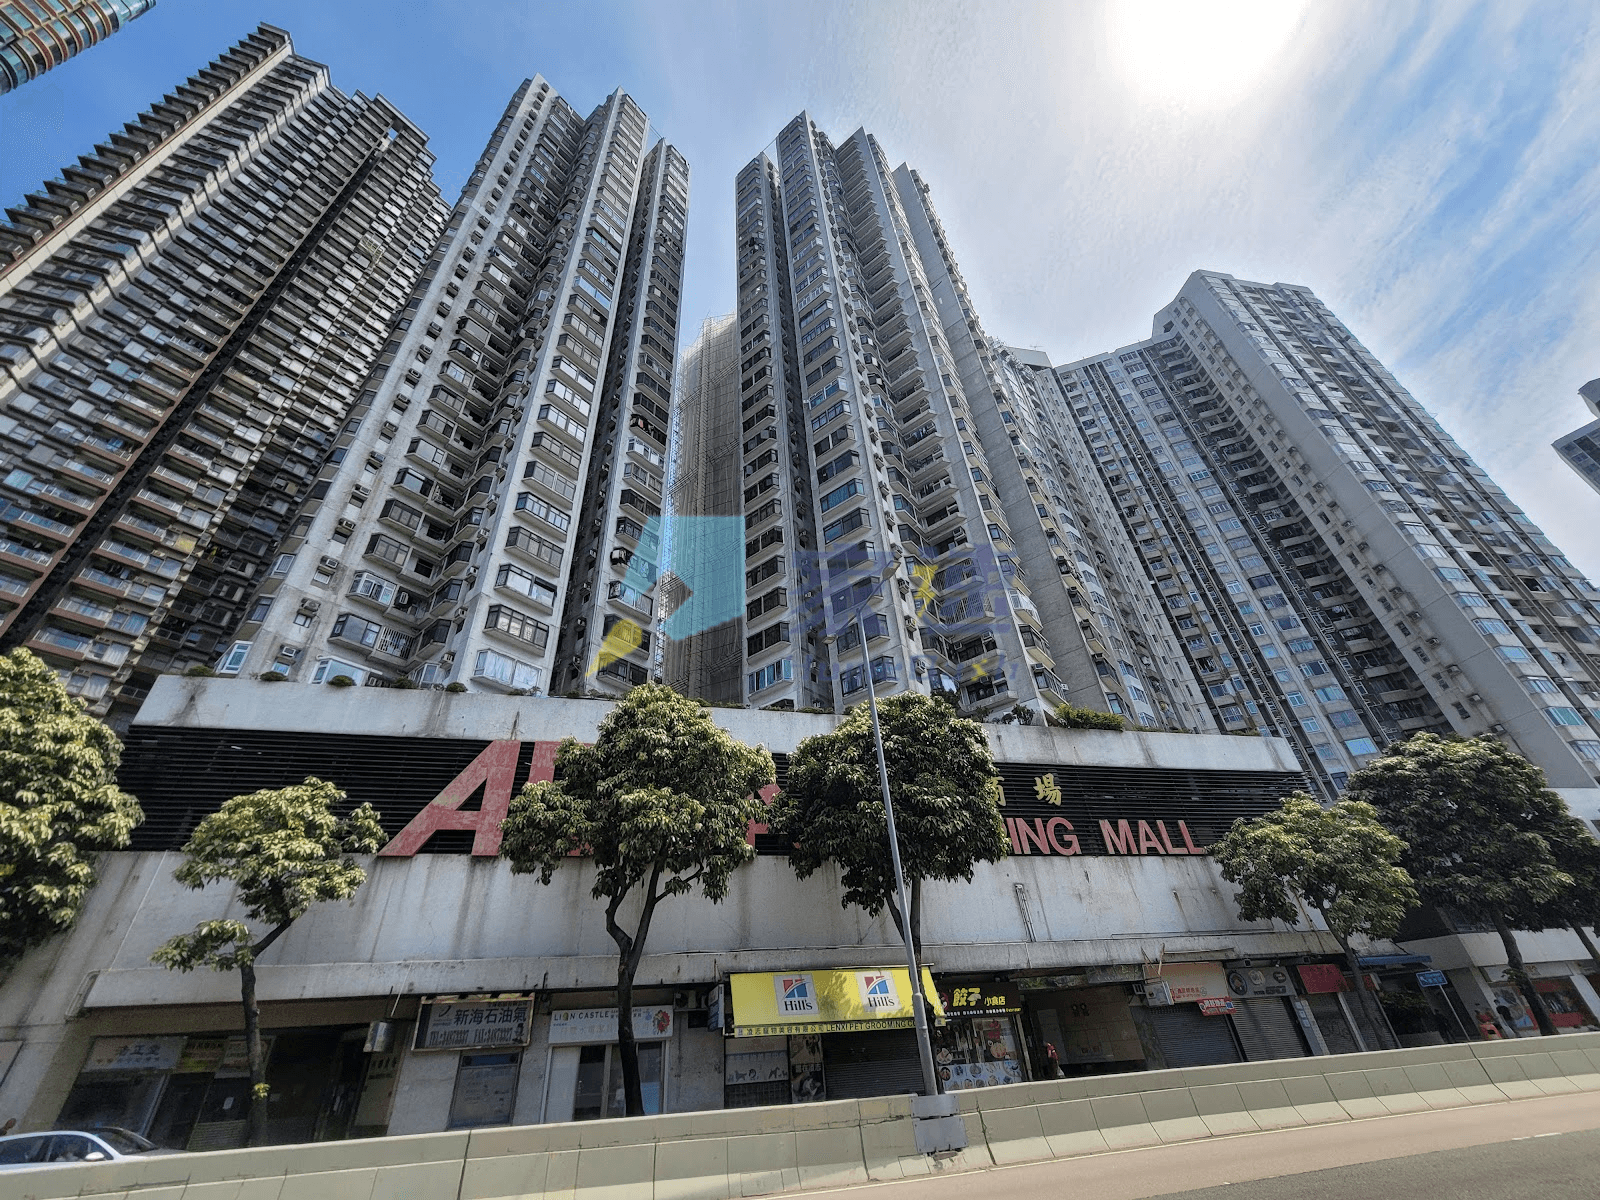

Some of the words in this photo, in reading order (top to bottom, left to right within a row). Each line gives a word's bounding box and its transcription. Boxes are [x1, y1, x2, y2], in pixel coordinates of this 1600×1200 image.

[1099, 818, 1206, 855] MALL
[868, 996, 895, 1008] Hill's
[952, 987, 982, 1007] 餃子
[784, 999, 813, 1011] Hill's
[453, 1005, 527, 1026] 新海石油氣
[579, 1010, 609, 1020] CASTLE
[826, 1023, 848, 1032] LENXI
[849, 1022, 864, 1031] PET
[865, 1020, 906, 1030] GROOMING
